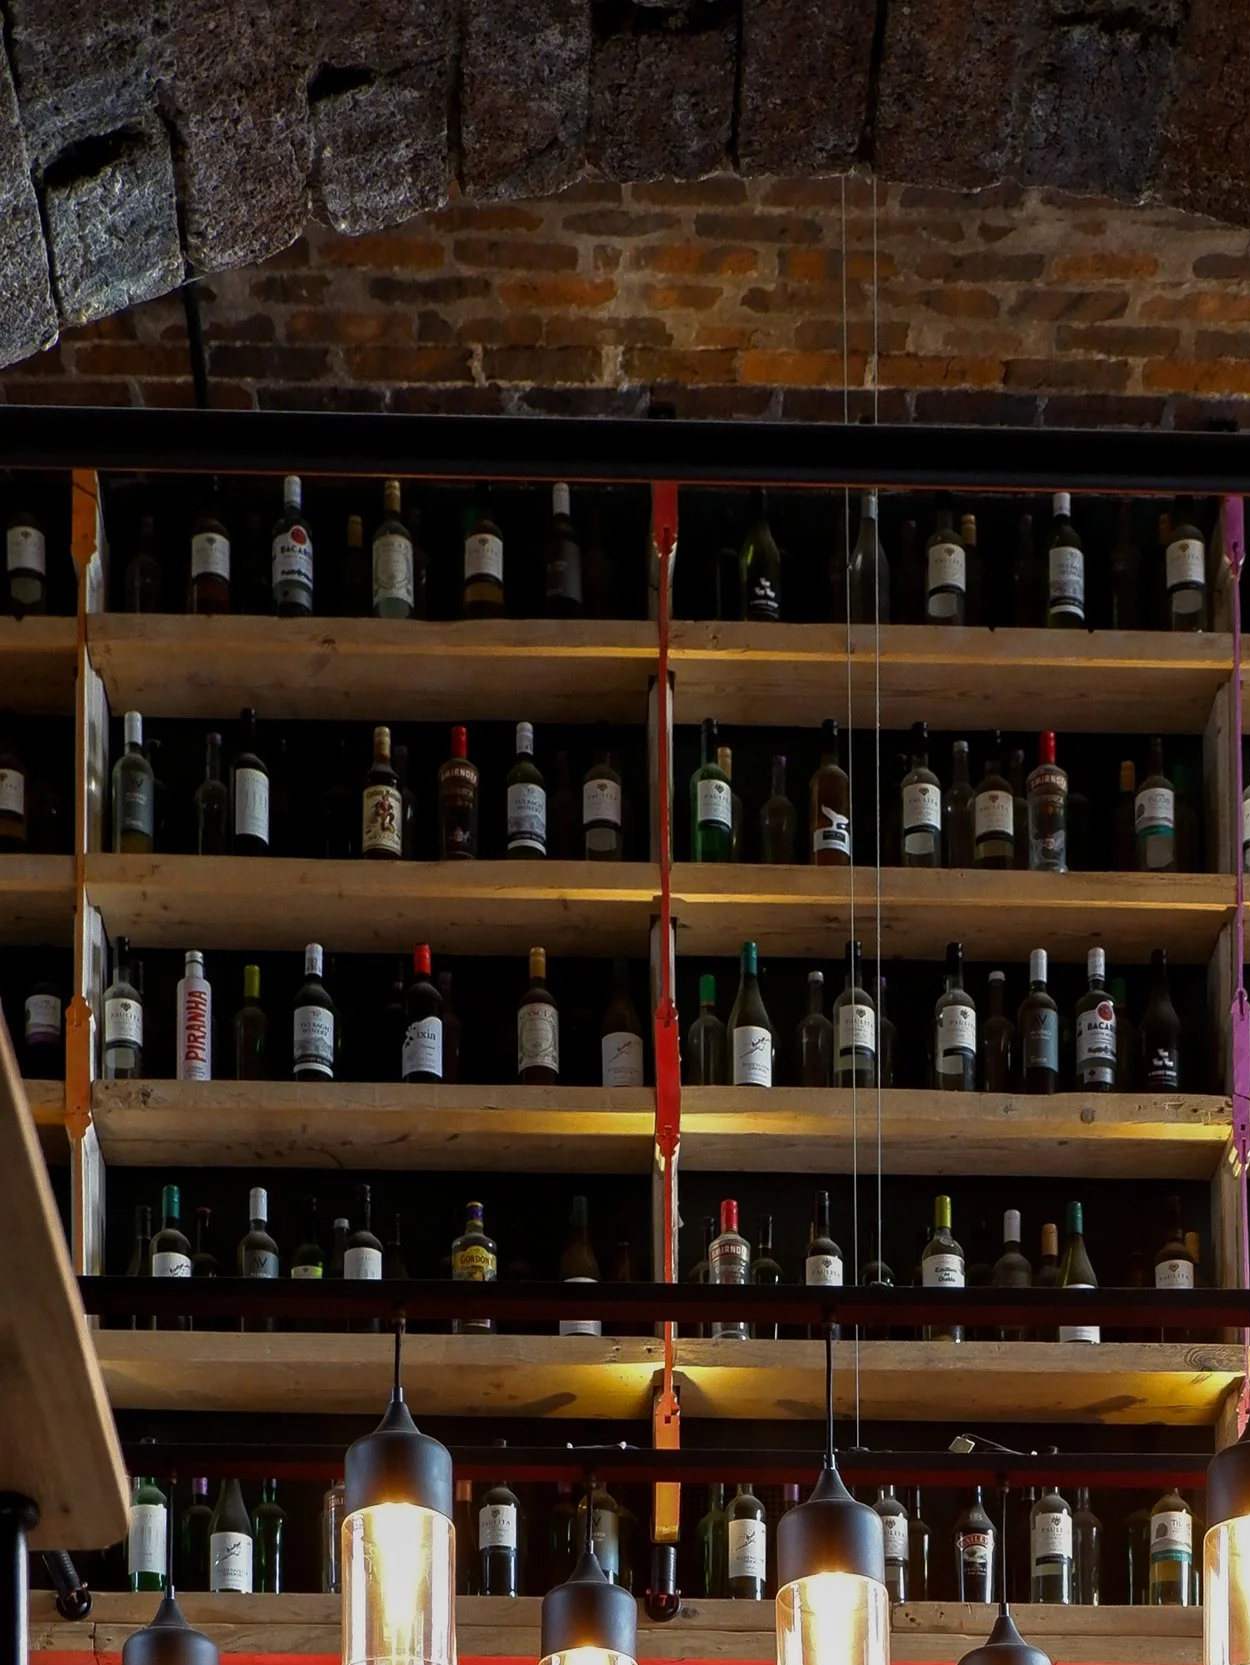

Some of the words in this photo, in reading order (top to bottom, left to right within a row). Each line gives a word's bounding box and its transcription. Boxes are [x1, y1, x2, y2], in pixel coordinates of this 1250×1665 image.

[280, 544, 313, 560] BACARD
[185, 990, 207, 1063] PIRANHA
[1087, 1021, 1117, 1034] BACAR
[711, 1244, 747, 1258] SMIRNO
[459, 1254, 492, 1264] GORDON
[961, 1534, 989, 1548] BAILEY
